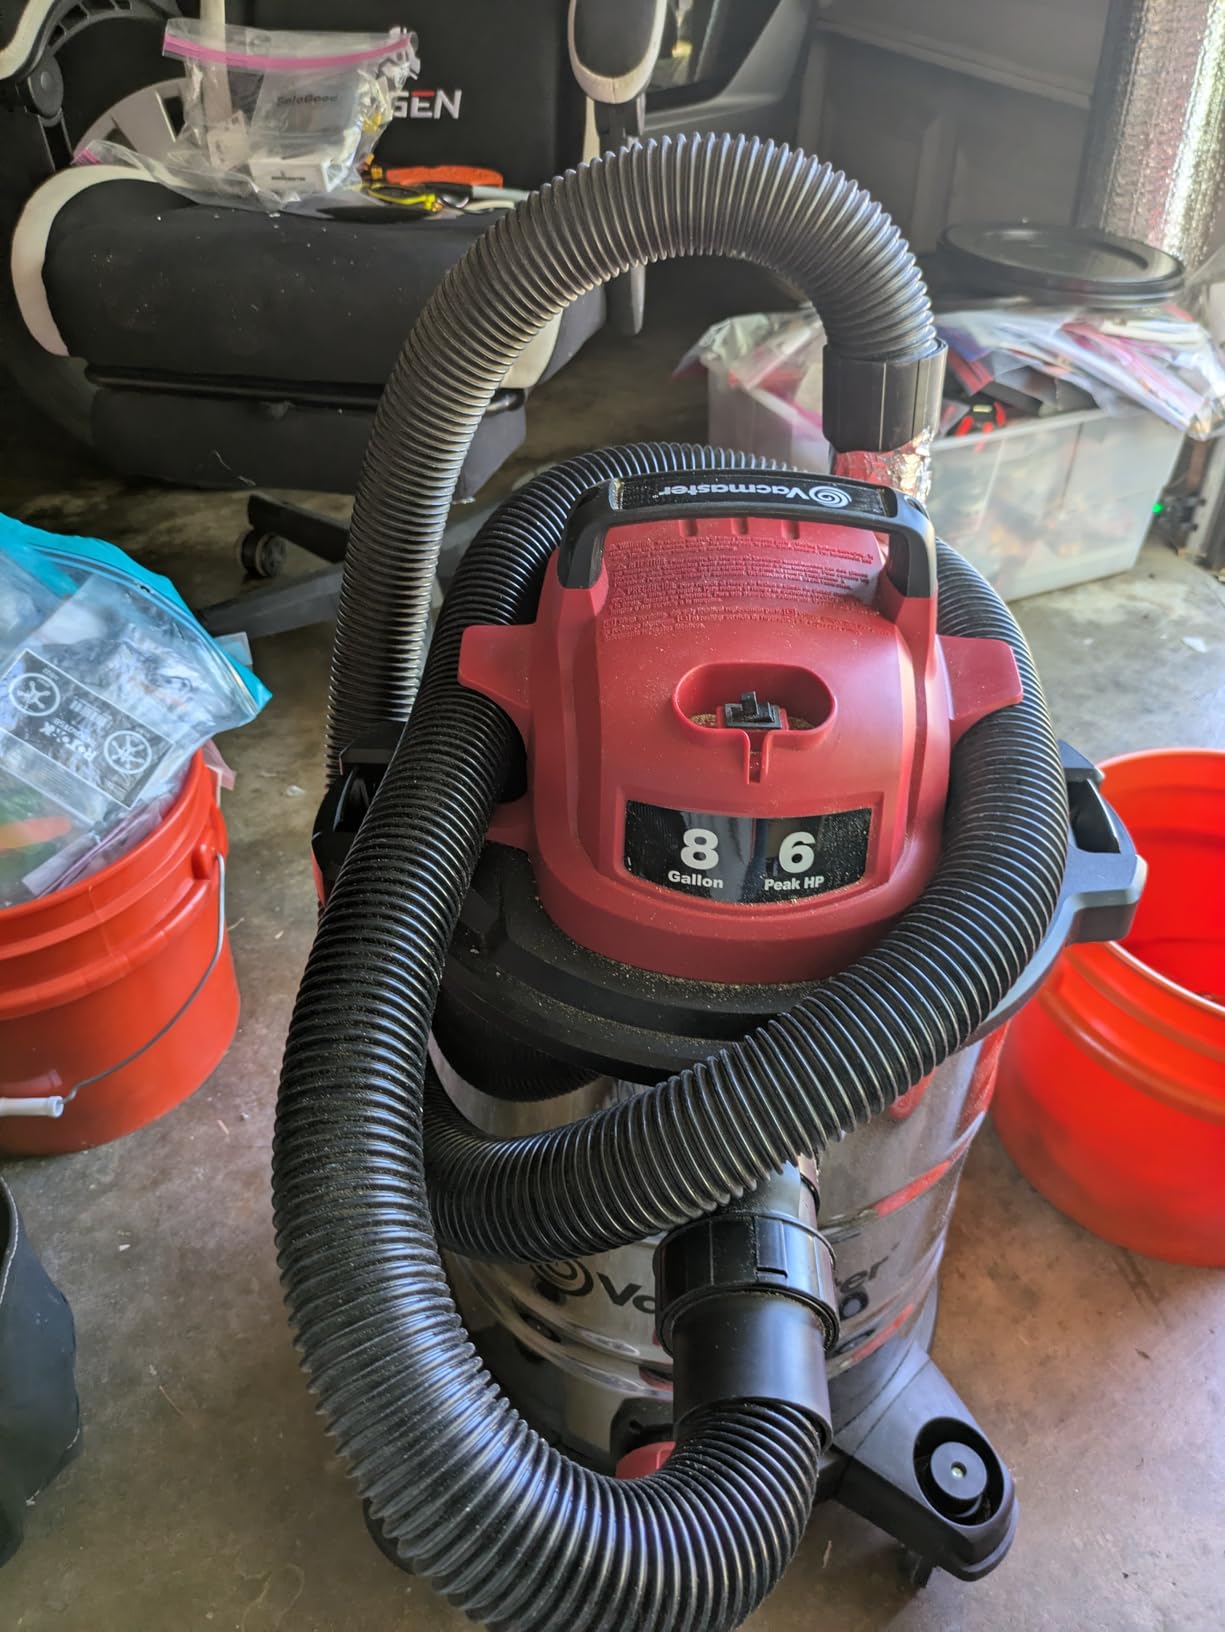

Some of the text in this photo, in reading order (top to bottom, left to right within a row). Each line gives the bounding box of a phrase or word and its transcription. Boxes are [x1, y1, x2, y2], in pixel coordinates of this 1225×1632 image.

[658, 483, 810, 500] Vacmaster
[680, 828, 720, 870] 8
[778, 831, 816, 874] 6
[667, 870, 724, 888] Gallon
[764, 874, 825, 891] Peak HP
